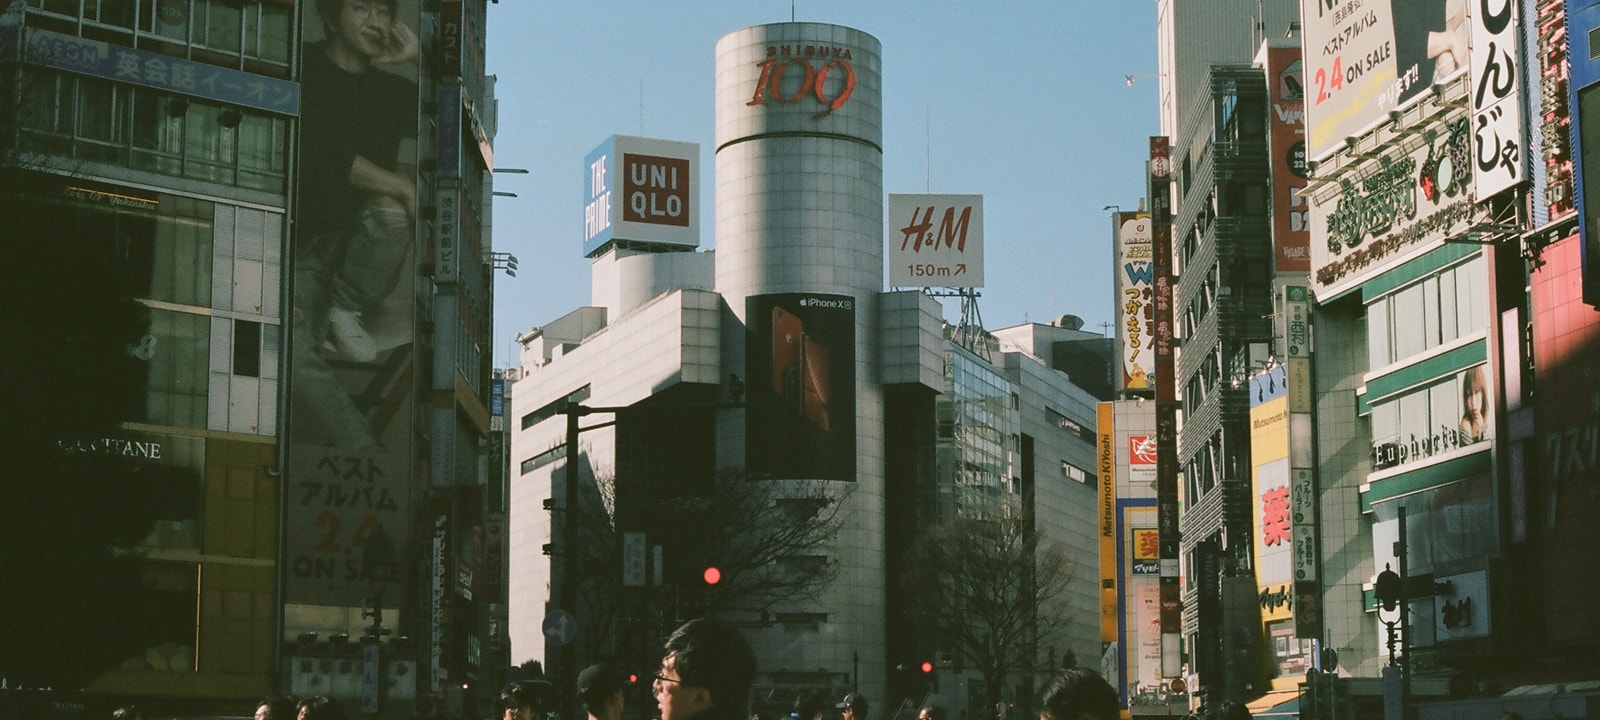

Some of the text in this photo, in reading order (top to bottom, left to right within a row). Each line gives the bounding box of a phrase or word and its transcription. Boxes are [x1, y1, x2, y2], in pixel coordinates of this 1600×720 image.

[766, 45, 852, 60] SHIBUYA
[1322, 9, 1378, 56] ベストアルバム
[115, 50, 294, 107] 英会話イーオン
[745, 56, 857, 120] 109
[1314, 41, 1391, 106] 2.4 ON SALE
[591, 155, 606, 199] THE
[631, 162, 677, 189] UNI
[585, 190, 611, 242] PRIME
[631, 191, 682, 219] QLO
[440, 196, 453, 275] 渋谷駅前ビル
[900, 206, 972, 253] H&M
[907, 264, 951, 276] 150m
[1124, 262, 1153, 286] W
[807, 298, 837, 307] iPhone
[1125, 288, 1143, 364] つかえる!
[1376, 427, 1458, 467] Euphoria
[317, 456, 383, 483] ベスト
[1102, 433, 1112, 537] Matsumoto KiYoshi
[300, 480, 397, 513] アルバム
[1262, 485, 1290, 547] 薬
[1140, 531, 1159, 557] 薬
[293, 556, 335, 579] ON
